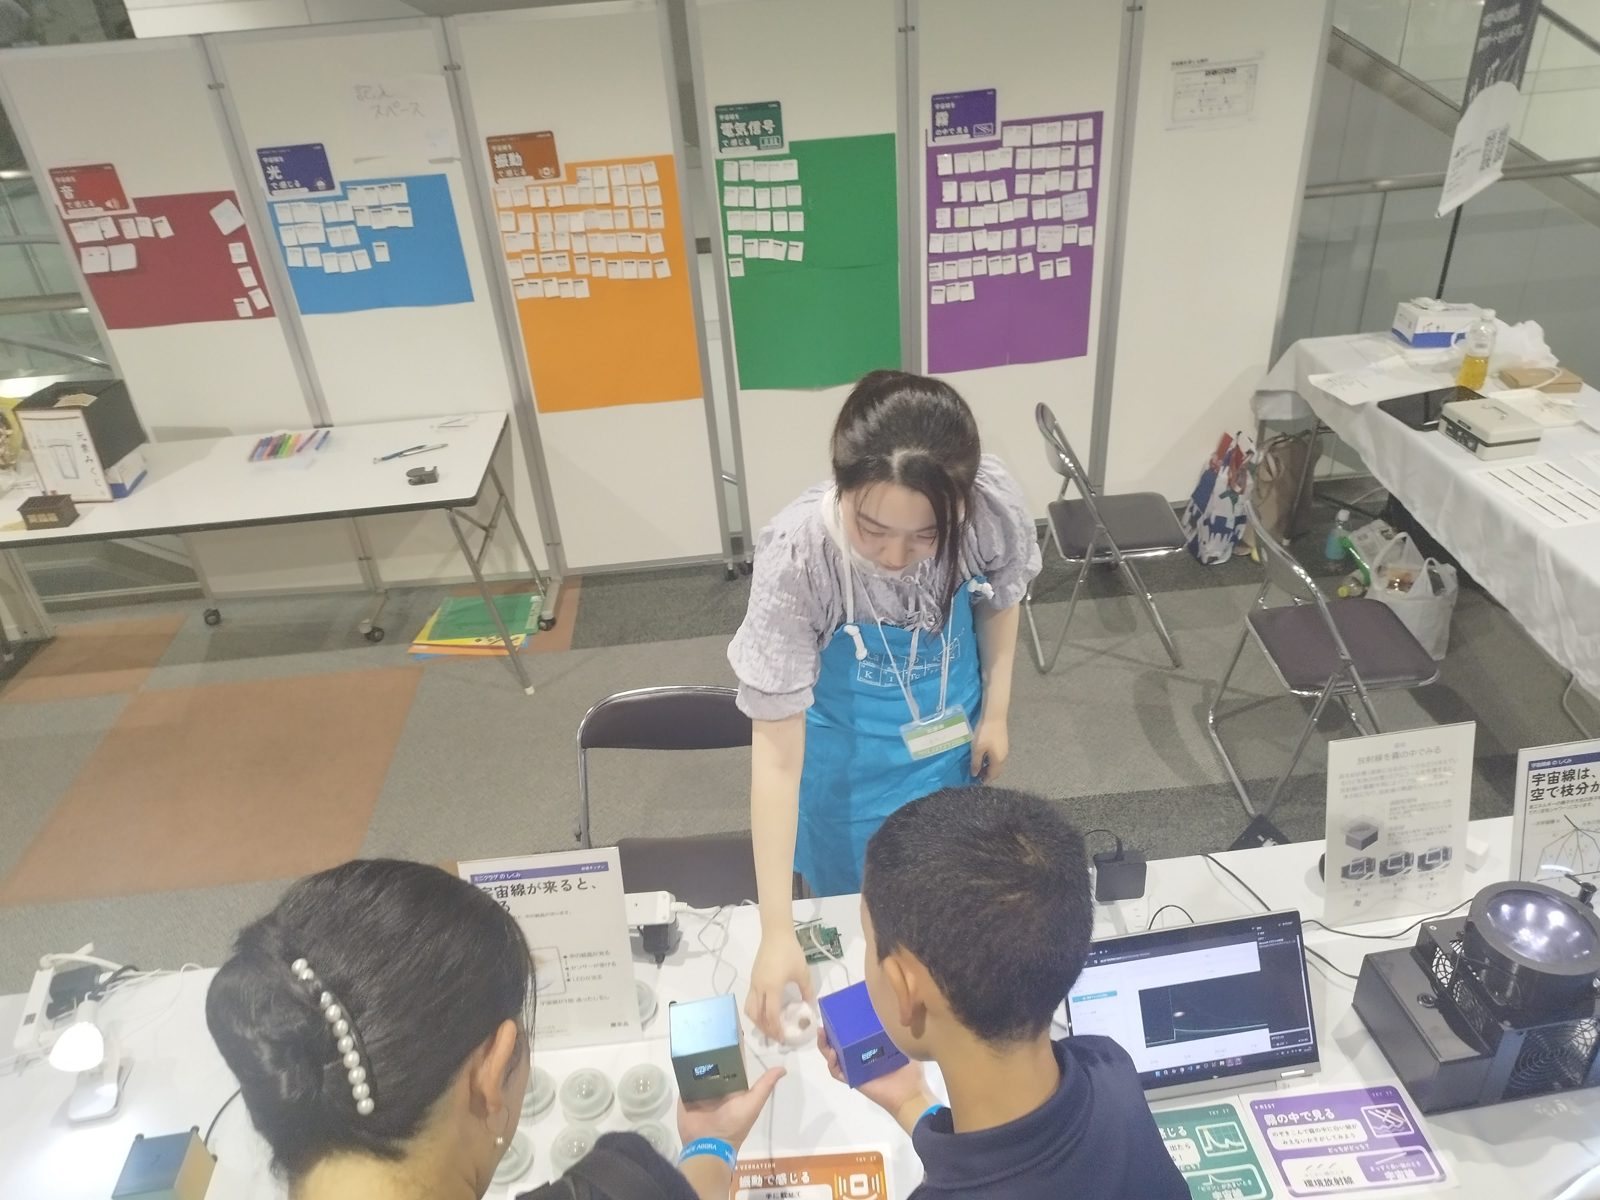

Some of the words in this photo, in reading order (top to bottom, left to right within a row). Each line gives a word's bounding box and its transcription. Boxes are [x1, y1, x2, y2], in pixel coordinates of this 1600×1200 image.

[720, 119, 776, 138] 電気信号
[494, 152, 523, 169] 振動
[266, 164, 283, 181] 光
[59, 185, 75, 200] 音
[1531, 768, 1596, 787] 宇宙線は、
[1263, 1108, 1335, 1127] 霧の中で見る
[739, 1171, 810, 1189] 振動で感じる
